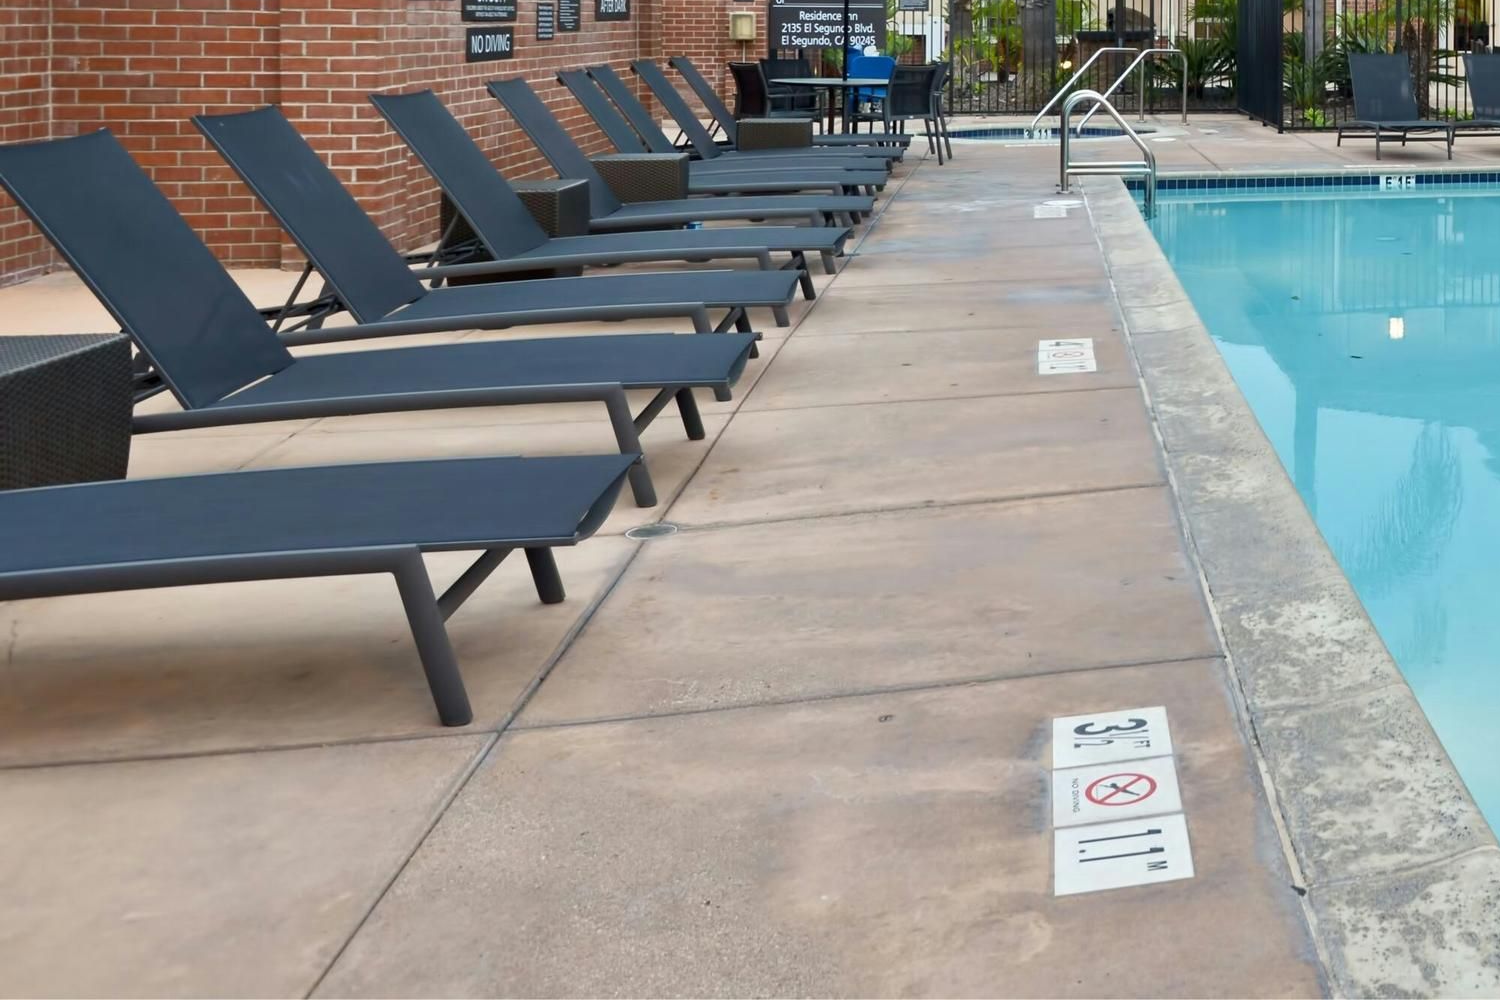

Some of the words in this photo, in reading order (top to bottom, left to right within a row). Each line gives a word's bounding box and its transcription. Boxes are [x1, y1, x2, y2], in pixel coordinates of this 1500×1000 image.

[614, 0, 627, 13] DARK
[799, 11, 842, 21] Residence
[781, 23, 802, 33] 2135
[804, 23, 812, 33] El
[854, 23, 876, 33] Blvd.
[471, 35, 484, 54] NO
[485, 34, 511, 53] DIVING
[781, 35, 789, 45] El
[791, 35, 832, 48] Segundo,
[850, 35, 876, 45] 90245
[1072, 778, 1079, 789] NO
[1072, 790, 1081, 813] DIVING
[1147, 860, 1168, 872] M
